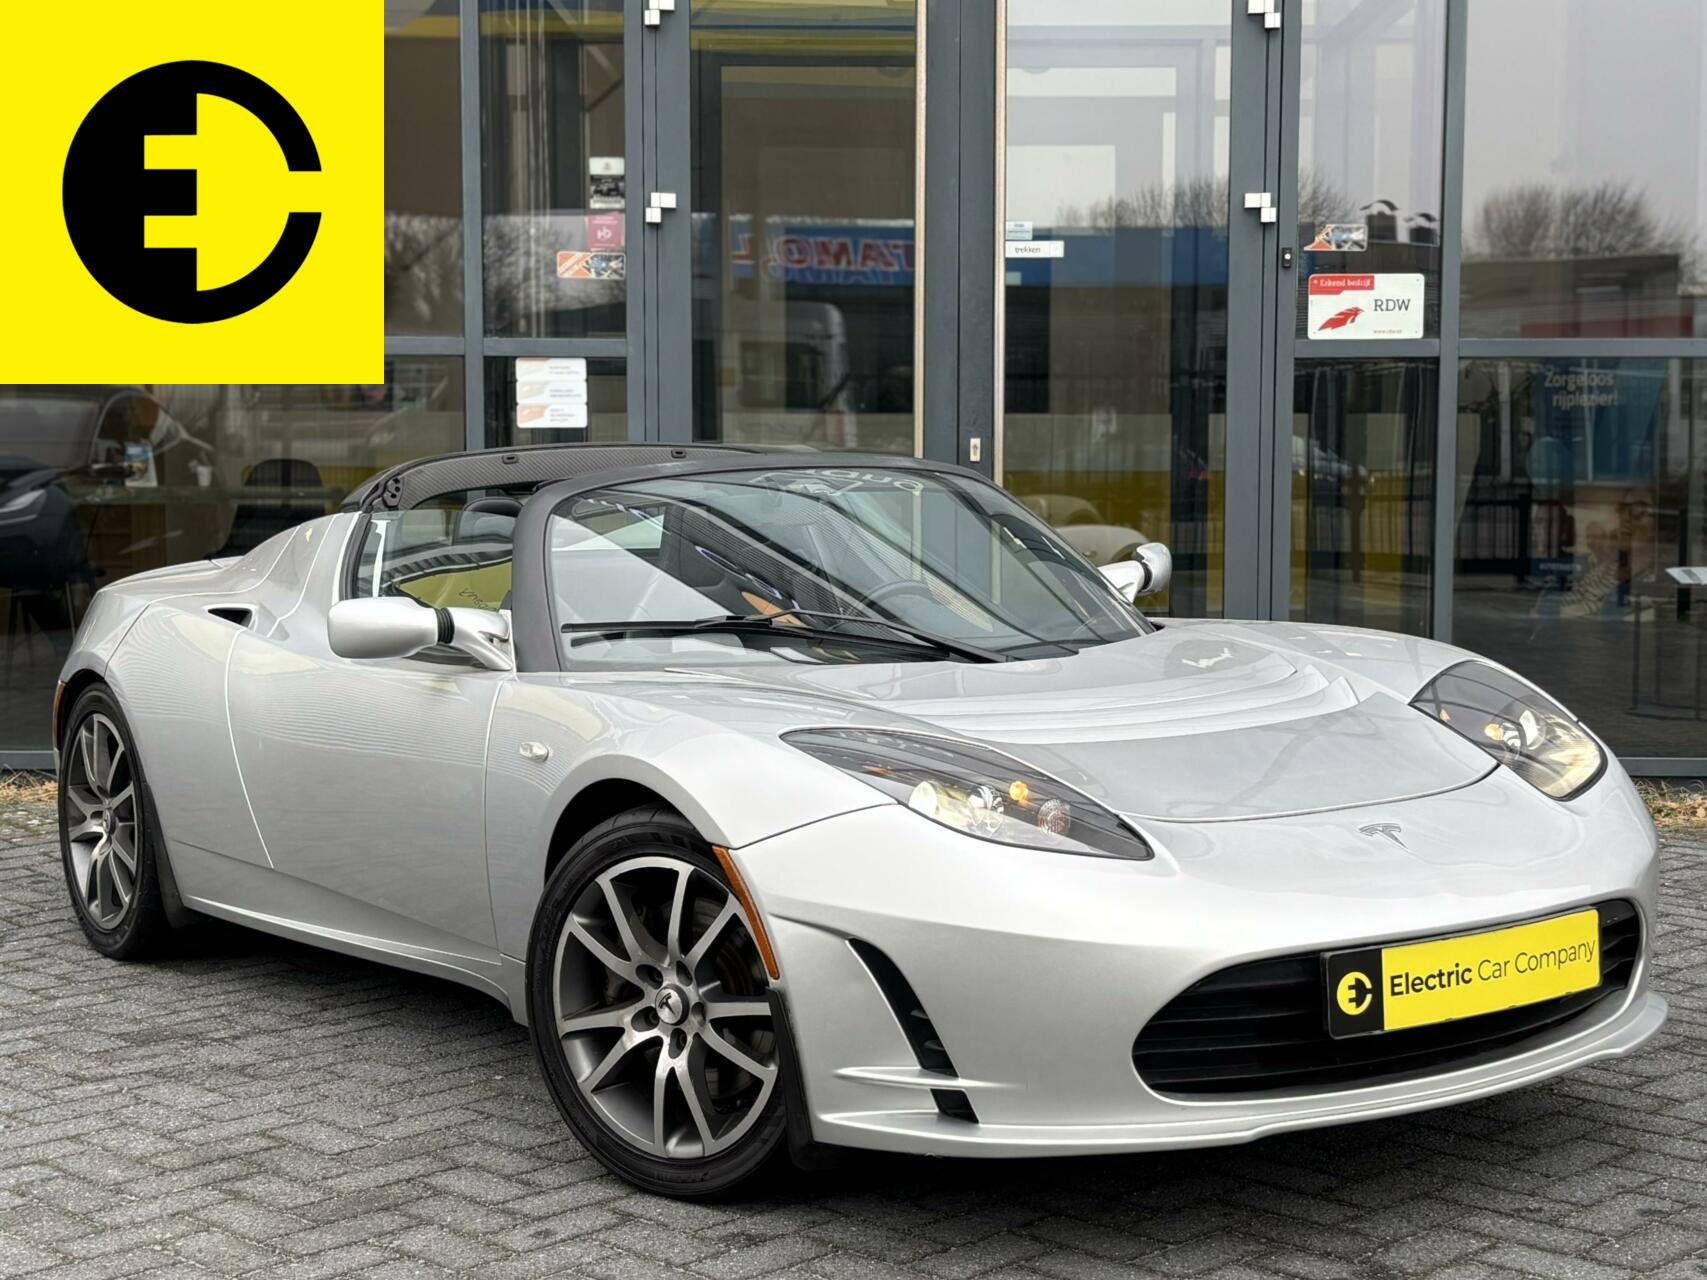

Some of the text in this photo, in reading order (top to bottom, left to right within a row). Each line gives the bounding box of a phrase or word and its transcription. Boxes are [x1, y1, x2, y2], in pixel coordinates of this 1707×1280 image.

[1373, 298, 1411, 312] RDW
[1544, 371, 1615, 391] Zorgeloos
[1389, 939, 1597, 997] Electric Car Company
